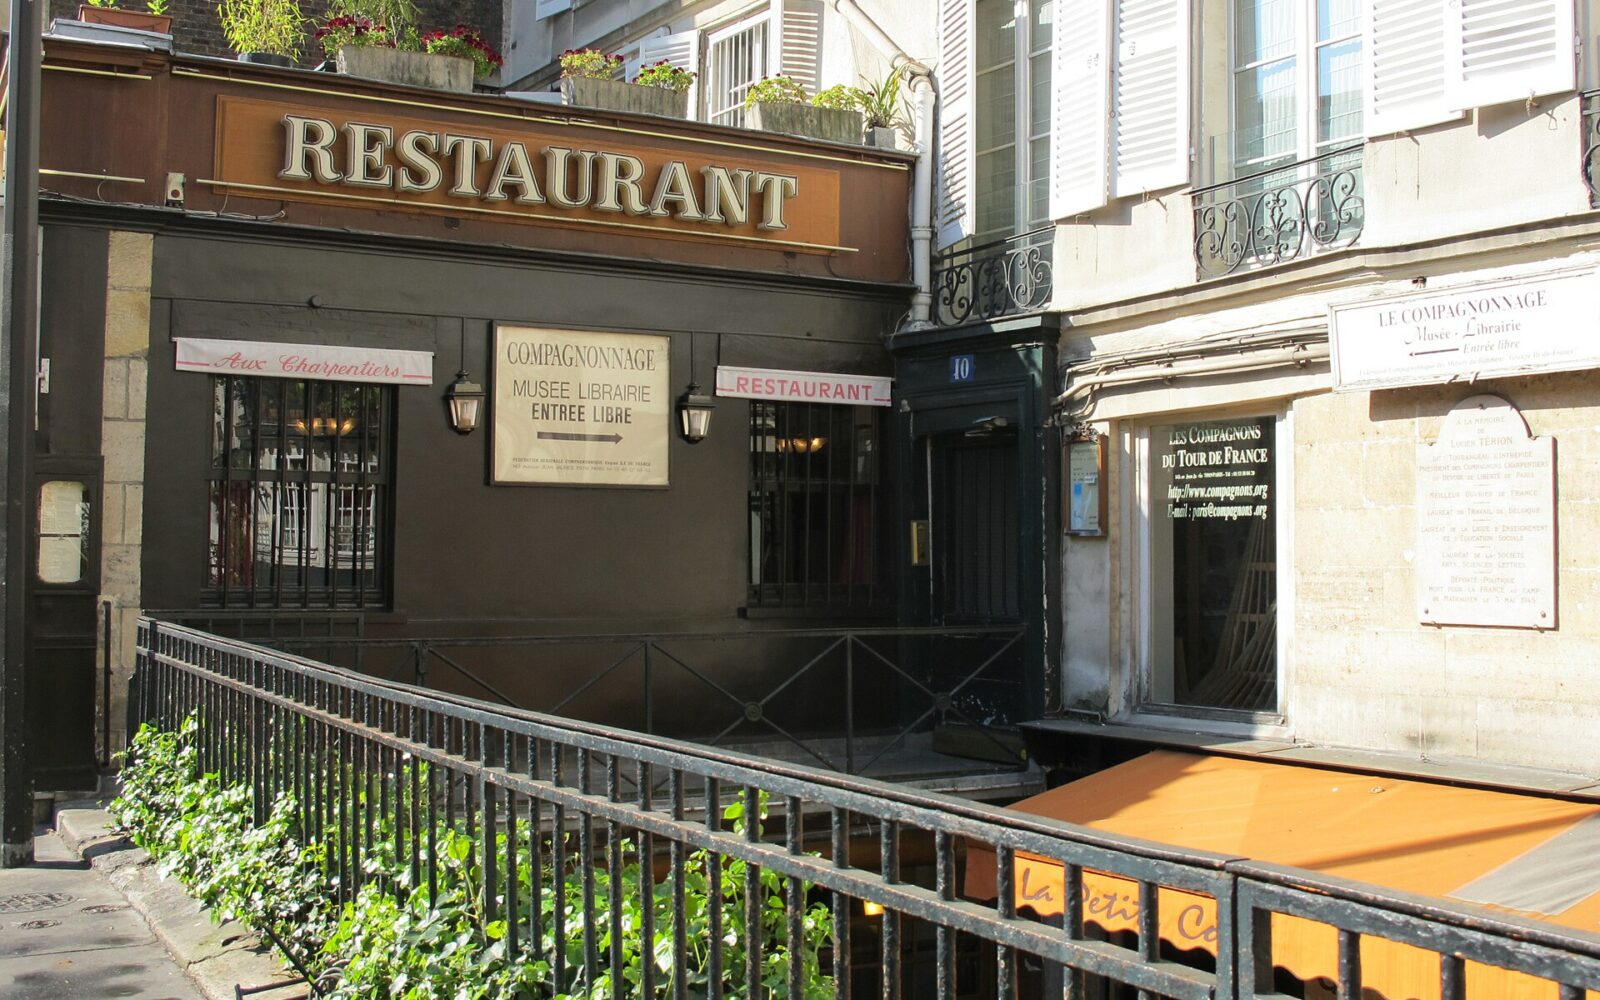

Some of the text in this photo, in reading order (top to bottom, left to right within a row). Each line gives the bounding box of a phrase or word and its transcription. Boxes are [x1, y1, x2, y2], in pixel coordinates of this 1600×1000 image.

[277, 113, 798, 231] RESTAURANT
[1378, 290, 1547, 327] LE COMPAGNONNAGE
[1404, 326, 1452, 345] Musée
[1462, 317, 1521, 339] Librairie
[507, 342, 657, 371] COMPAGNONNAGE
[1463, 338, 1520, 354] Entrée libre
[214, 351, 400, 377] Aux Charpentiers
[953, 358, 969, 380] 10
[513, 380, 651, 402] MUSEE LIBRAIRIE
[736, 376, 873, 401] RESTAURANT
[532, 403, 632, 424] ENTREE LIBRE
[1169, 425, 1261, 445] LES COMPAGNONS
[1162, 446, 1268, 468] DU TOUR DE FRANCE
[1480, 585, 1505, 593] FRANCE
[1022, 868, 1053, 901] La
